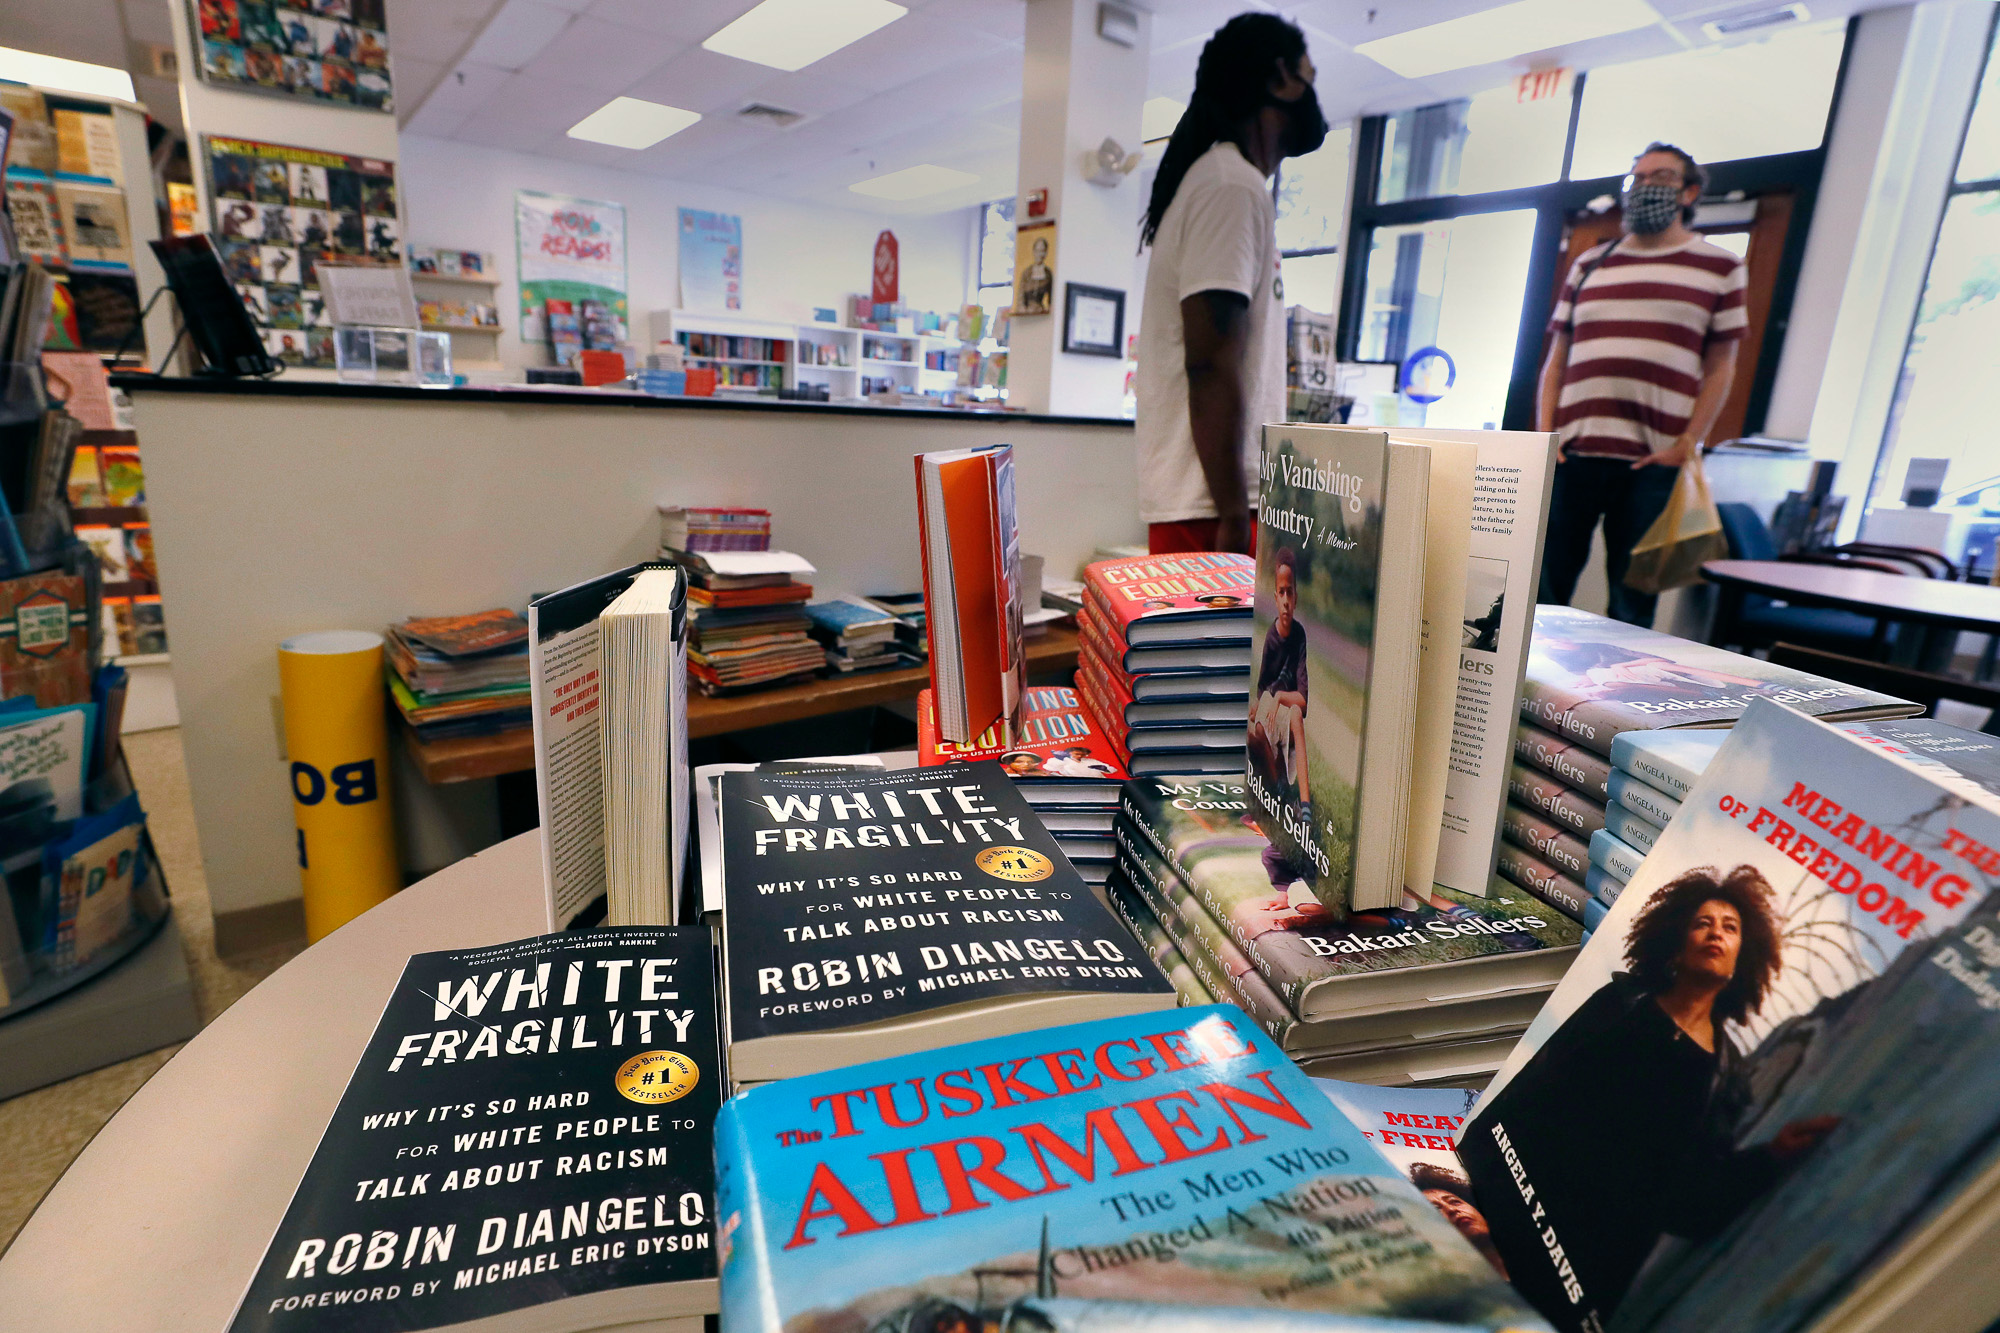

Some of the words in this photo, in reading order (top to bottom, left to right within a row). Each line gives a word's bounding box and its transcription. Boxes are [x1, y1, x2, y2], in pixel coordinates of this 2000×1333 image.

[1516, 66, 1565, 104] EXIT
[551, 209, 598, 233] ROX
[1260, 450, 1277, 493] My
[1280, 454, 1363, 513] Vanishing
[1259, 493, 1314, 549] Country
[1317, 526, 1326, 545] A
[1325, 530, 1358, 551] Memoir
[1487, 516, 1506, 524] father
[1492, 527, 1513, 536] family
[1103, 553, 1256, 585] CHANGING
[1458, 675, 1492, 687] twenty-two
[1459, 654, 1494, 676] lers
[1460, 685, 1491, 697] incumbent
[1622, 695, 1742, 714] Bakari
[1453, 721, 1477, 731] nominee
[1459, 731, 1486, 742] Carolina.
[1543, 702, 1596, 740] Sellers
[1014, 741, 1047, 750] Women
[1059, 736, 1085, 744] STEM
[1460, 740, 1483, 751] recently
[1455, 766, 1481, 777] Carolina.
[1536, 744, 1586, 784] Sellers
[1633, 760, 1666, 781] ANGELA
[1667, 775, 1675, 785] Y.
[761, 784, 998, 823] WHITE
[1155, 783, 1201, 797] My
[1206, 783, 1245, 795] Va
[1172, 798, 1247, 811] Coun
[1533, 787, 1584, 829] Sellers
[1625, 791, 1655, 813] ANGELA
[755, 816, 1026, 856] FRAGILITY
[1246, 759, 1281, 823] Bakari
[1283, 803, 1330, 879] Sellers
[1625, 824, 1653, 846] ANGELA
[991, 849, 1014, 857] York
[1017, 850, 1042, 863] Times
[1001, 858, 1031, 870] #1
[1527, 828, 1580, 872] Sellers
[1782, 781, 1972, 909] MEANING
[1940, 828, 2000, 877] THE
[757, 879, 806, 896] WHY
[817, 874, 861, 891] IT'S
[868, 872, 897, 886] SO
[906, 869, 964, 885] HARD
[994, 869, 1046, 879] BESTSELLER
[1718, 795, 1749, 819] OF
[1747, 806, 1927, 940] FREEDOM
[806, 902, 844, 914] FOR
[852, 890, 937, 910] WHITE
[948, 887, 1042, 905] PEOPLE
[1048, 891, 1073, 901] TO
[1124, 797, 1134, 817] My
[1134, 809, 1167, 858] Vanishing
[1167, 848, 1200, 896] Country
[1204, 889, 1236, 933] Bakari
[1236, 926, 1272, 978] Sellers
[1525, 867, 1579, 912] Sellers
[783, 920, 852, 944] TALK
[863, 912, 950, 935] ABOUT
[960, 908, 1065, 929] RACISM
[1119, 899, 1148, 955] Vanishing
[1127, 837, 1157, 890] Vanishing
[1157, 880, 1190, 925] Country
[1193, 924, 1223, 968] Bakari
[1224, 962, 1257, 1014] Sellers
[1131, 868, 1161, 920] Vanishing
[1161, 913, 1190, 959] Country
[1195, 957, 1226, 1004] Bakari
[1299, 926, 1426, 957] Bakari
[1425, 914, 1548, 941] Sellers
[463, 947, 515, 960] NECESSARY
[519, 942, 543, 950] BOOK
[587, 932, 620, 940] PEOPLE
[468, 955, 511, 966] SOCIETAL
[757, 951, 903, 996] ROBIN
[919, 937, 1125, 972] DIANGELO
[434, 957, 679, 1022] WHITE
[759, 993, 874, 1019] FOREWORD
[883, 986, 907, 1001] BY
[917, 969, 1015, 992] MICHAEL
[1024, 965, 1071, 979] ERIC
[1080, 965, 1144, 979] DYSON
[387, 1008, 696, 1073] FRAGILITY
[623, 1062, 640, 1078] New
[640, 1055, 666, 1066] York
[668, 1056, 689, 1075] Times
[641, 1067, 673, 1085] #1
[775, 1129, 823, 1148] The
[810, 1020, 1258, 1140] TUSKEGEE
[628, 1083, 687, 1099] BESTSELLER
[361, 1110, 416, 1131] WHY
[427, 1102, 476, 1123] IT'S
[486, 1098, 517, 1115] SO
[527, 1091, 591, 1112] HARD
[396, 1143, 439, 1160] FOR
[453, 1126, 543, 1154] WHITE
[555, 1114, 661, 1141] PEOPLE
[671, 1118, 696, 1131] TO
[355, 1172, 431, 1203] TALK
[441, 1159, 544, 1192] ABOUT
[555, 1147, 668, 1177] RACISM
[782, 1071, 1313, 1252] AIRMEN
[1100, 1187, 1177, 1223] The
[1182, 1166, 1266, 1203] Men
[1268, 1142, 1350, 1178] Who
[1050, 1215, 1214, 1281] Changed
[1223, 1205, 1257, 1236] A
[1259, 1173, 1380, 1224] Nation
[1491, 1122, 1536, 1205] ANGELA
[1531, 1201, 1546, 1229] Y.
[1541, 1225, 1584, 1305] DAVIS
[285, 1223, 457, 1280] ROBIN
[476, 1191, 706, 1256] DIANGELO
[1287, 1225, 1322, 1247] 4th
[268, 1284, 401, 1314] FOREWORD
[411, 1278, 441, 1296] BY
[453, 1251, 561, 1291] MICHAEL
[570, 1240, 626, 1267] ERIC
[636, 1232, 709, 1256] DYSON
